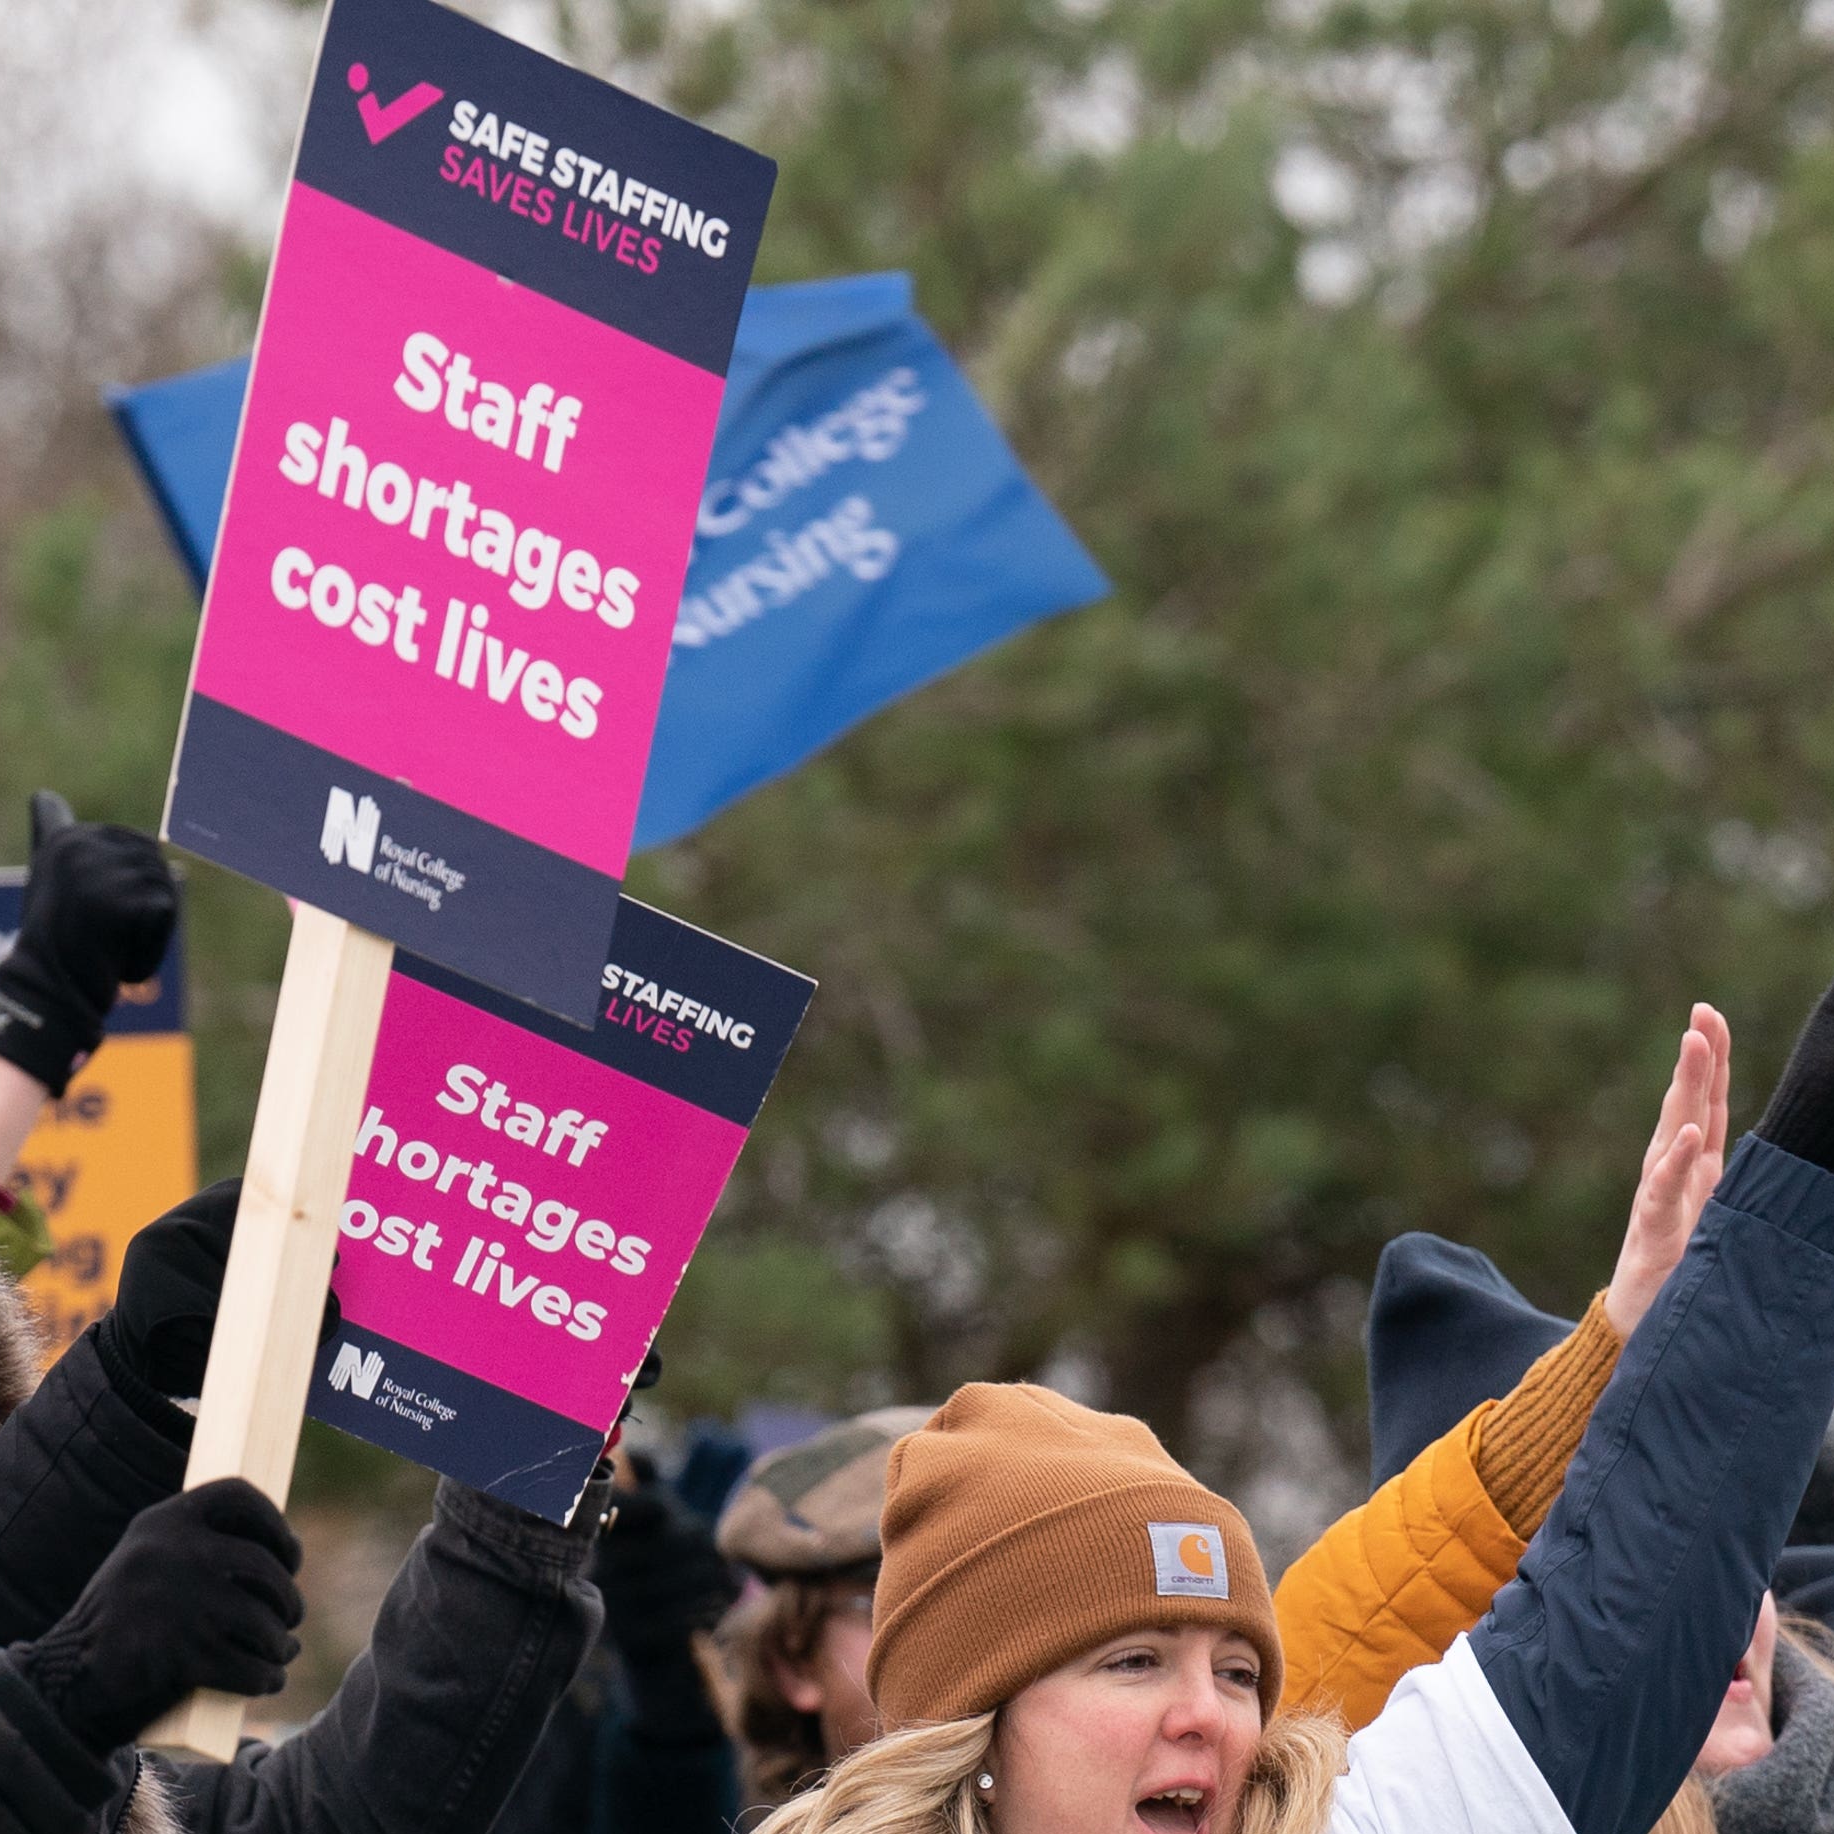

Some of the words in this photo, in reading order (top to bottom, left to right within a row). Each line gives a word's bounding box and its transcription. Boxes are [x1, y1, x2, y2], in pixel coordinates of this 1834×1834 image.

[439, 144, 557, 226] SAVES
[561, 199, 663, 275] LIVES
[448, 99, 549, 176] SAFE
[549, 147, 731, 259] STAFFING
[393, 331, 583, 474] Staff
[278, 415, 641, 630] shortages
[672, 494, 902, 648] ursing
[270, 546, 428, 663] cost
[434, 597, 604, 740] lives
[373, 862, 398, 881] of
[390, 866, 442, 912] Nursing
[379, 834, 418, 867] Royal
[416, 851, 466, 893] College
[600, 963, 756, 1050] STAFFING
[604, 997, 693, 1054] LIVES
[434, 1062, 609, 1168] Staff
[353, 1104, 653, 1277] hortages
[338, 1199, 442, 1273] ost
[451, 1236, 609, 1342] lives
[375, 1395, 389, 1409] of
[389, 1399, 434, 1432] Nursing
[382, 1377, 415, 1402] Royal
[415, 1392, 458, 1422] College
